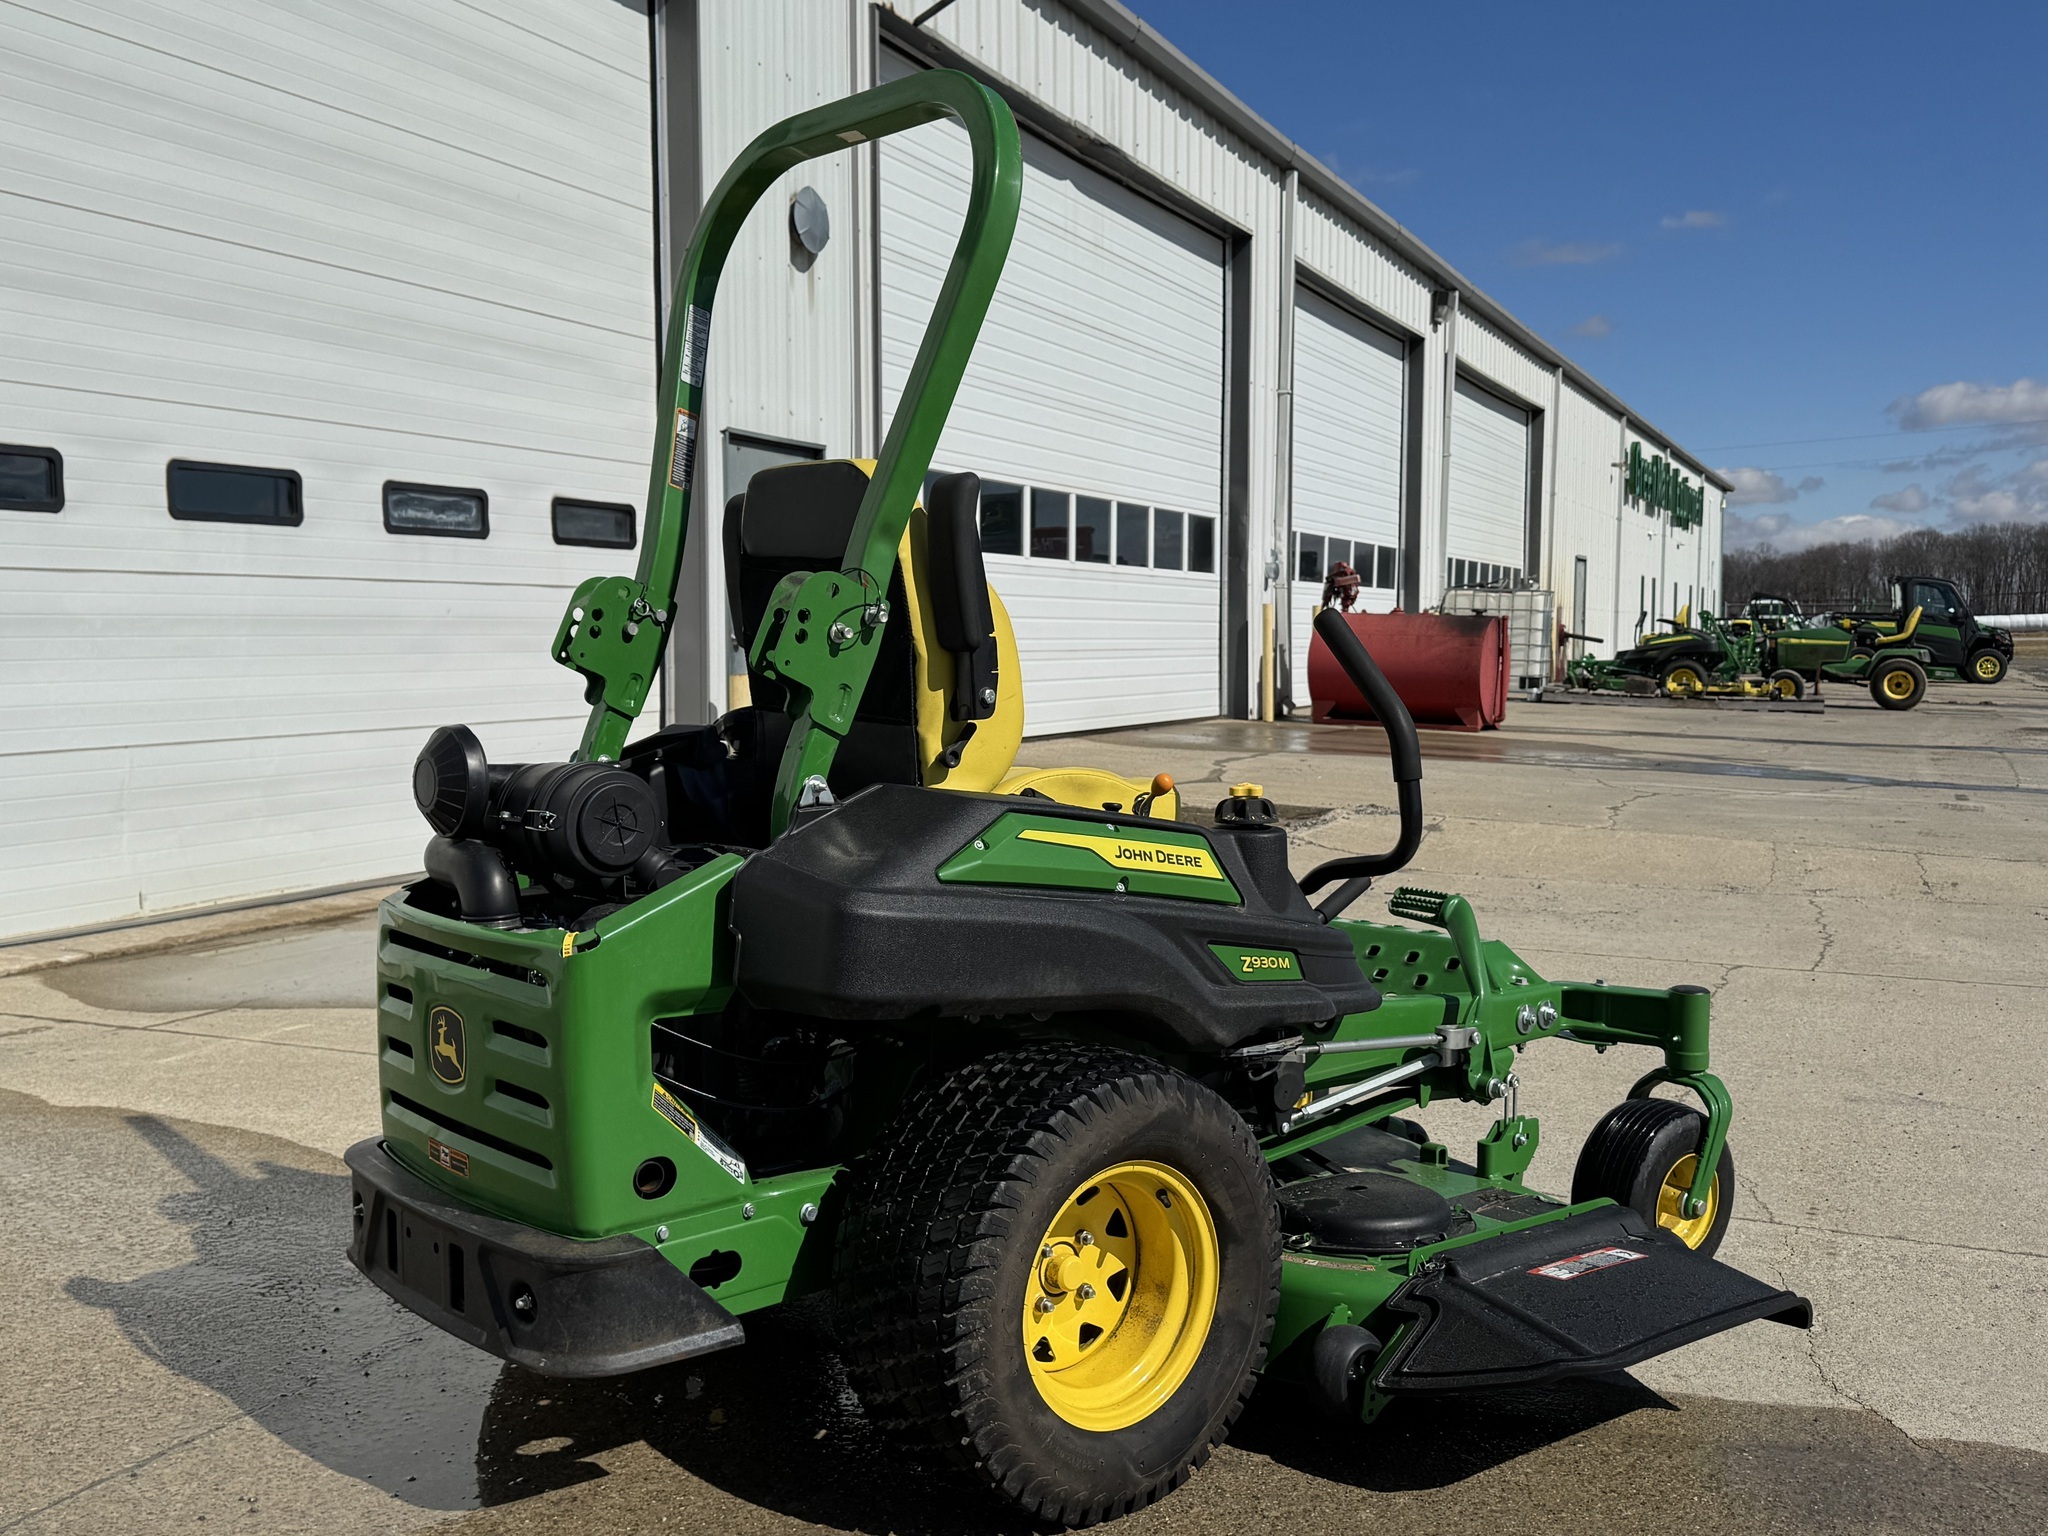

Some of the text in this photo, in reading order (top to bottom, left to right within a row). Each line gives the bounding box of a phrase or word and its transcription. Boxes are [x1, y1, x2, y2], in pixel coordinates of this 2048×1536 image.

[1115, 845, 1202, 868] JOHN DEERE
[1240, 956, 1290, 972] Z930M
